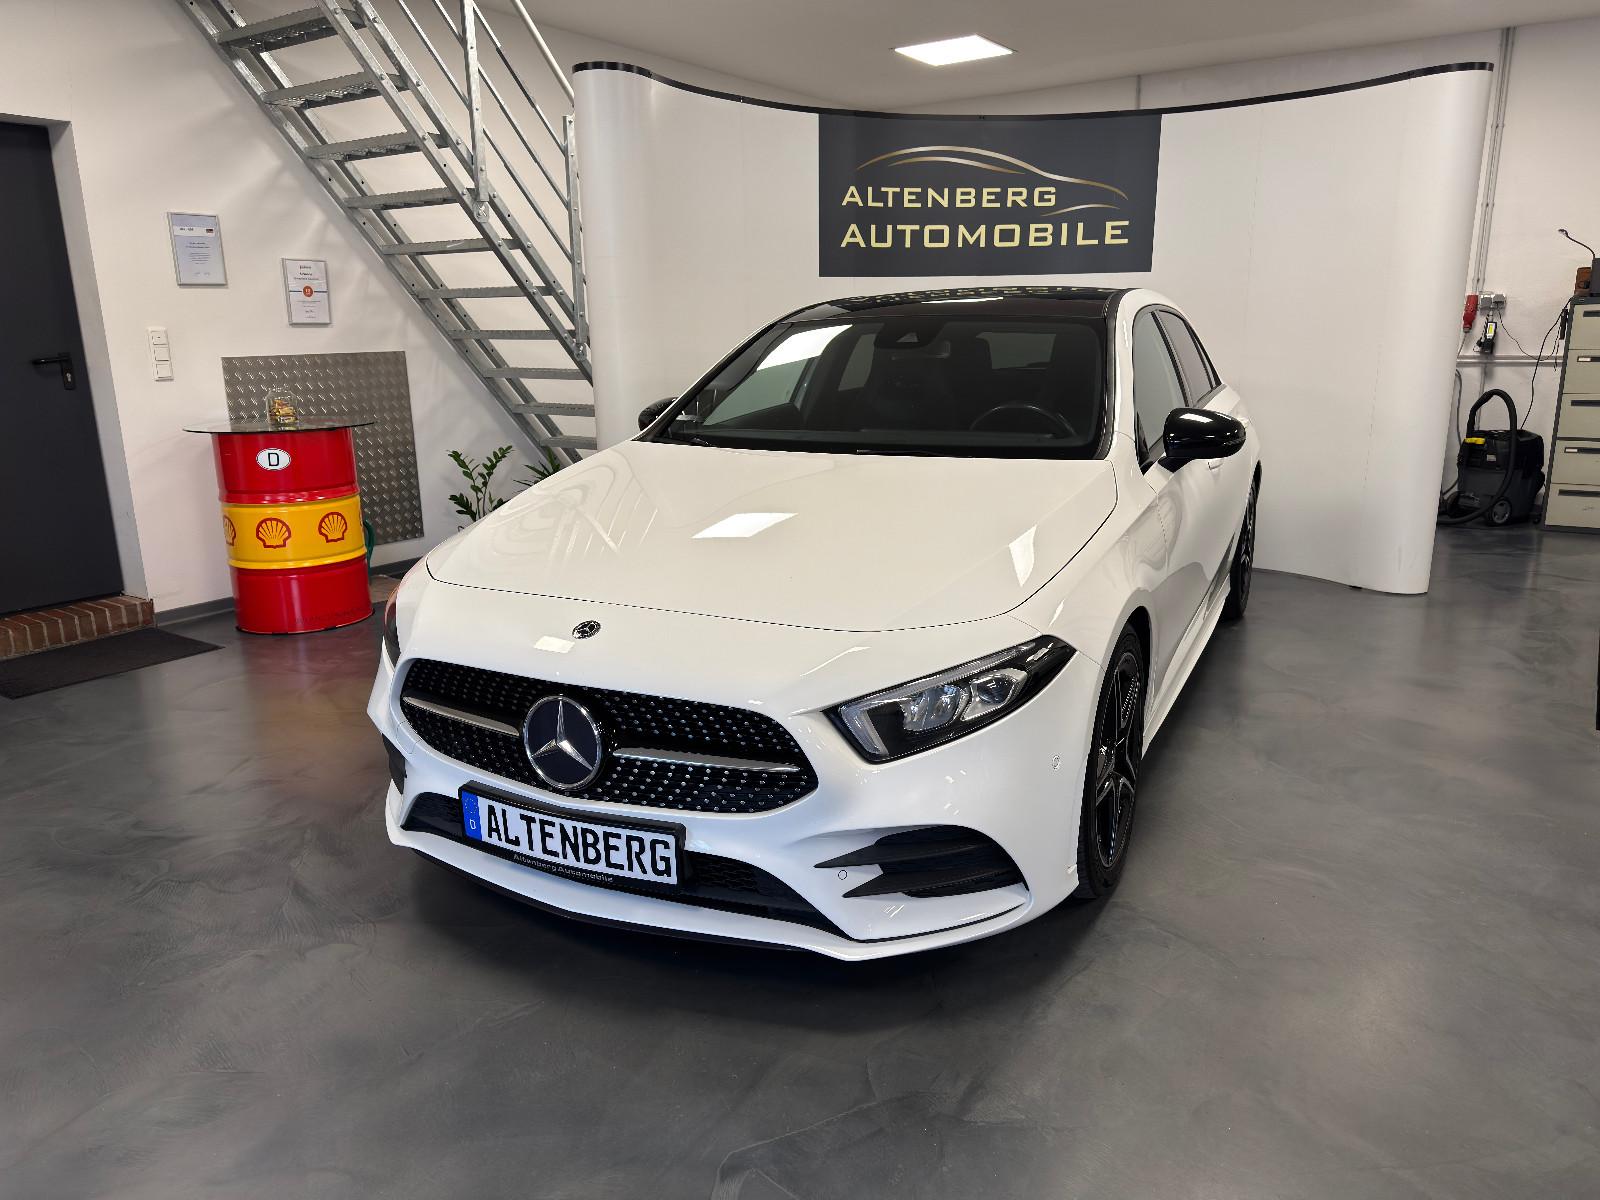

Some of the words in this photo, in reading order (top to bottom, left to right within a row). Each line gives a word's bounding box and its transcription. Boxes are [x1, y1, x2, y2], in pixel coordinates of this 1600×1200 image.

[841, 185, 1057, 208] ALTENBERG
[840, 220, 1130, 248] AUTOMOBILE
[267, 452, 280, 467] D
[469, 818, 477, 830] D
[487, 804, 672, 878] ALTENBERG
[513, 853, 557, 872] Altenberg
[557, 866, 614, 883] Automobile
